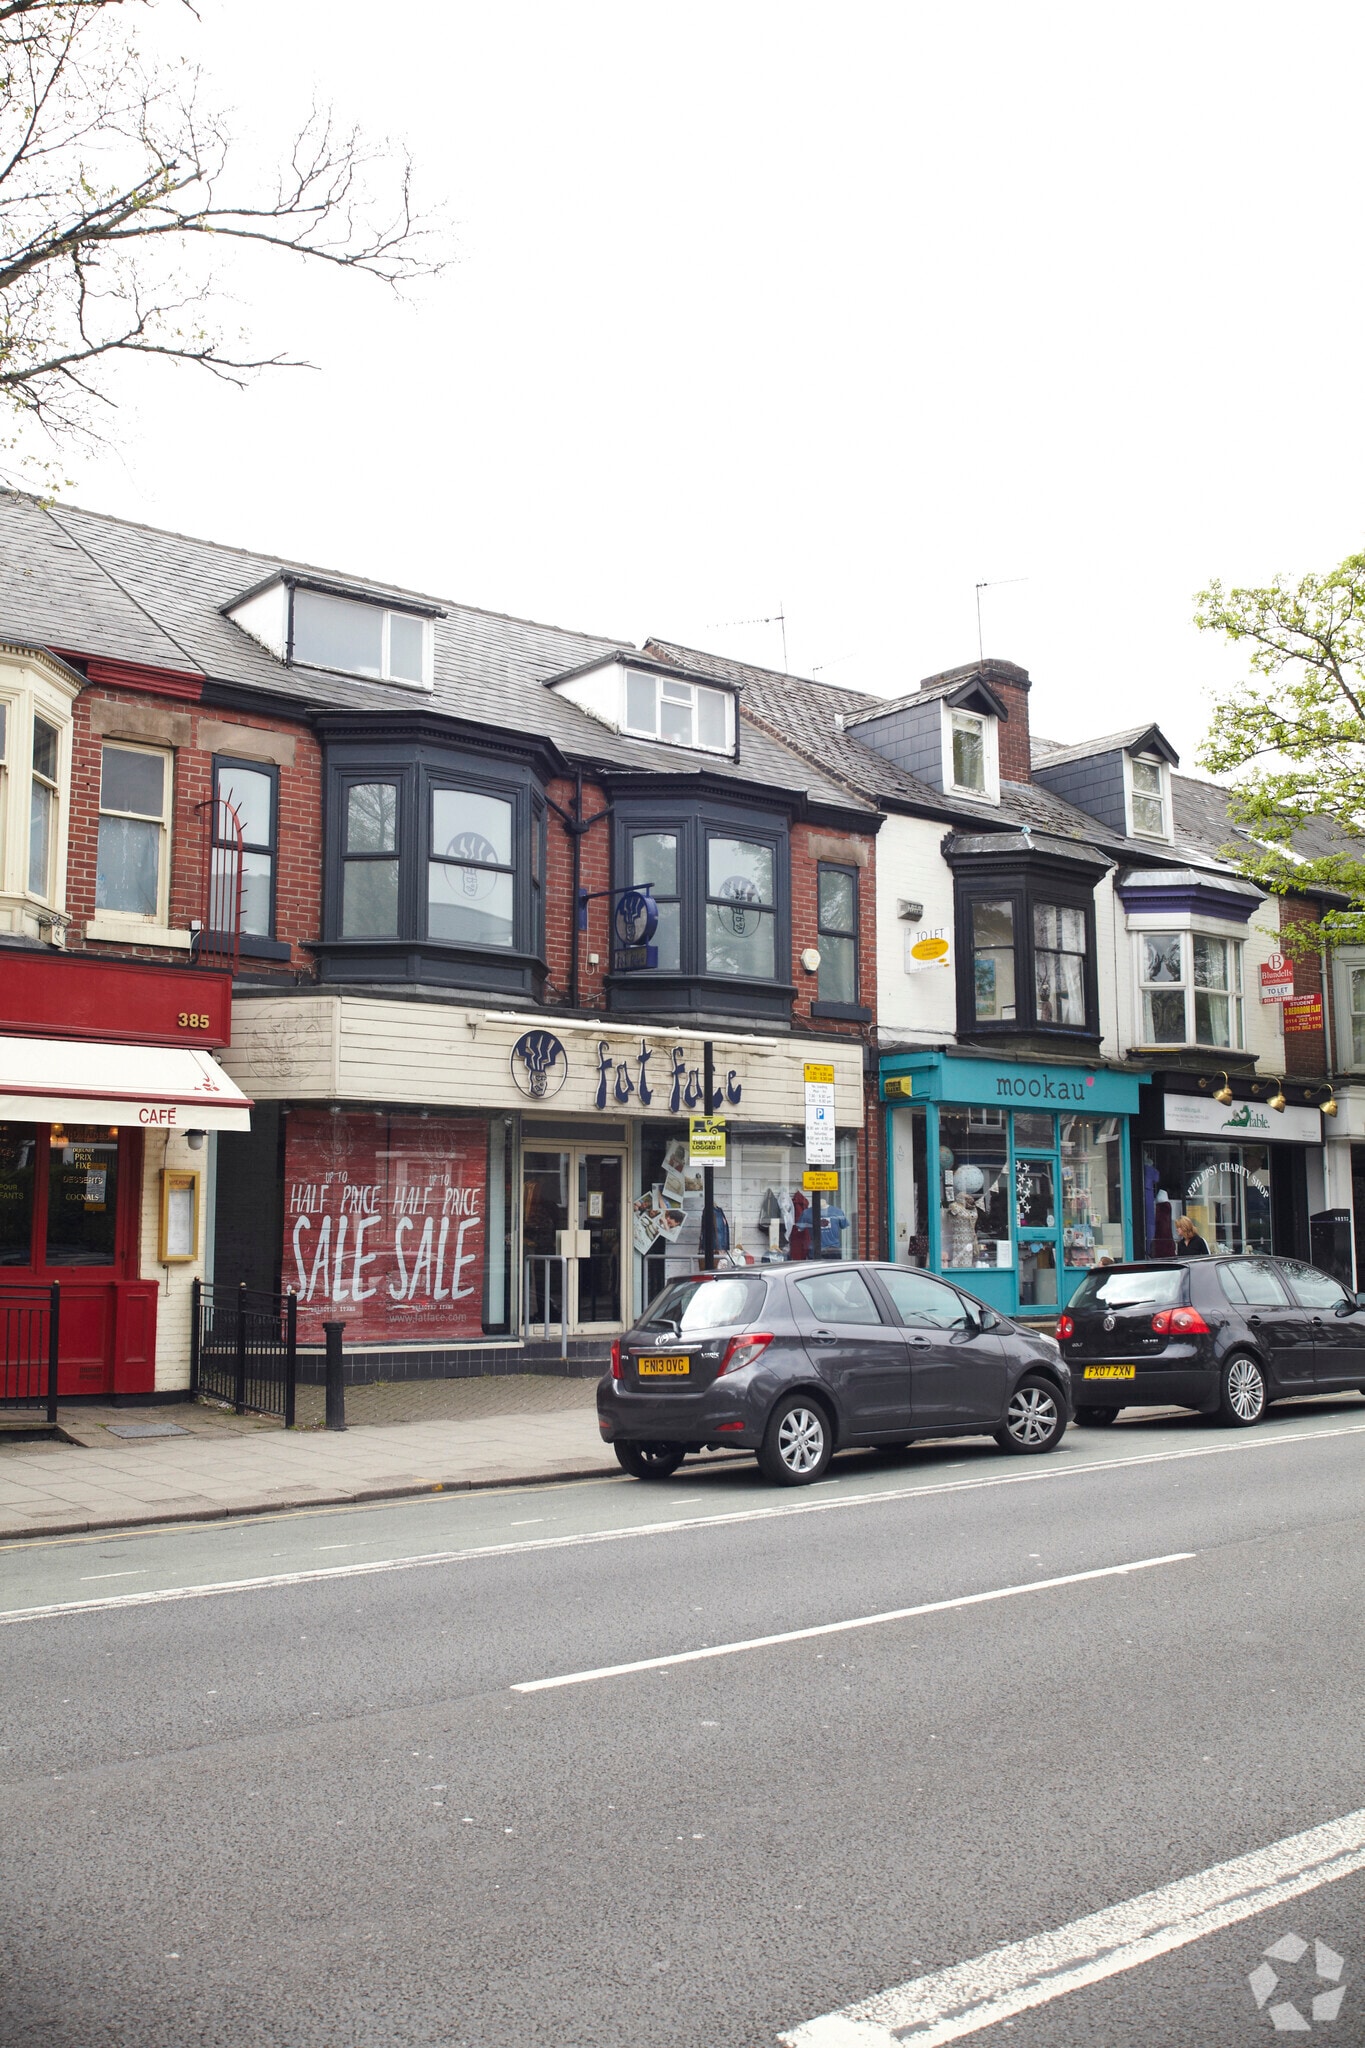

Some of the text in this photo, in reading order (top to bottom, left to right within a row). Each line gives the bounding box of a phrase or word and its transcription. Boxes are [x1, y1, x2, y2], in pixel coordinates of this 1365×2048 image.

[916, 928, 944, 942] TO LET
[1272, 954, 1282, 970] B
[1262, 969, 1292, 979] Blundells
[178, 1013, 209, 1028] 385
[595, 1039, 653, 1110] fat
[996, 1074, 1085, 1100] mookau
[139, 1107, 176, 1124] CAFÉ
[75, 1153, 92, 1161] PRIX
[75, 1162, 91, 1170] FIXE
[1187, 1162, 1269, 1199] EPILEPSY CHARITY SHOP
[290, 1184, 381, 1214] HALF PRICE
[393, 1186, 480, 1215] HALF PRICE
[287, 1215, 381, 1302] SALE
[389, 1216, 480, 1300] SALE
[644, 1359, 684, 1373] FN13 OVG
[1088, 1365, 1131, 1377] FX07 ZXN
